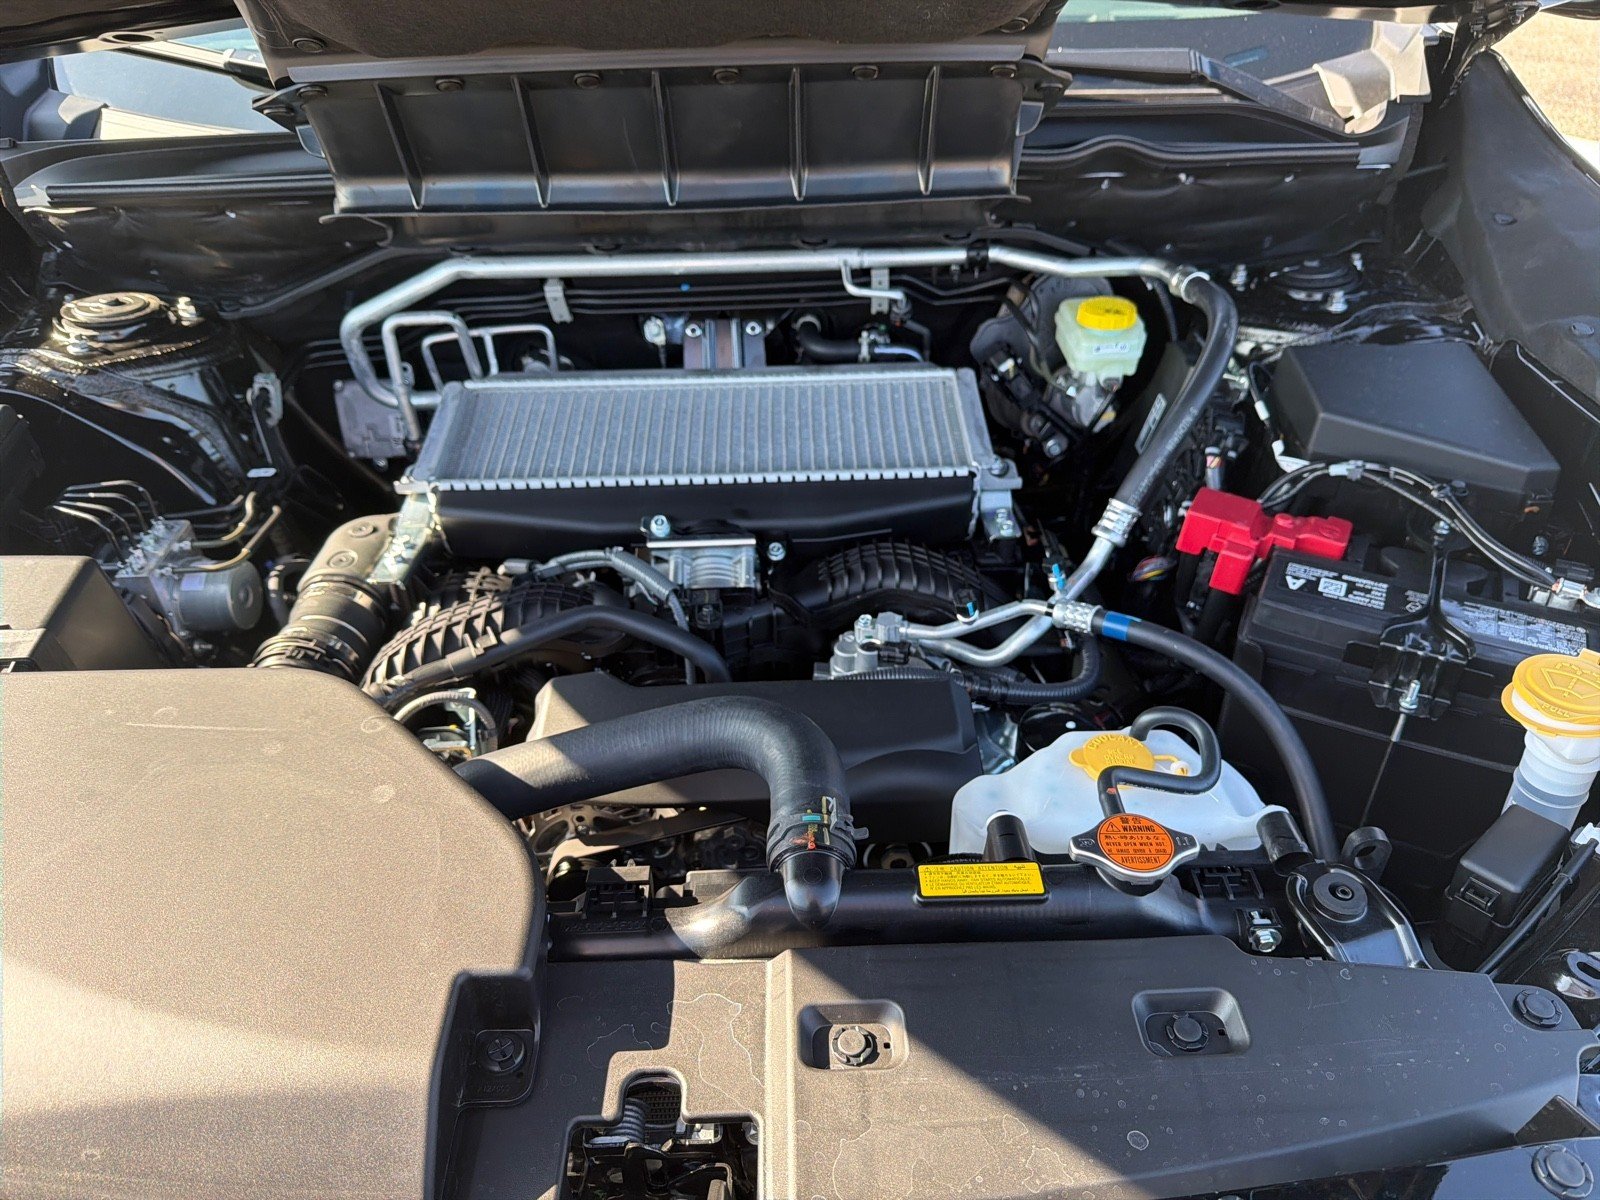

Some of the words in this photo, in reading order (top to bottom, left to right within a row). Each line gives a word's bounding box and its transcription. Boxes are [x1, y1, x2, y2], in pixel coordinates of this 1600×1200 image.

[1541, 702, 1570, 718] PULL
[1088, 734, 1144, 750] COOLANT
[1121, 825, 1156, 833] WARNING
